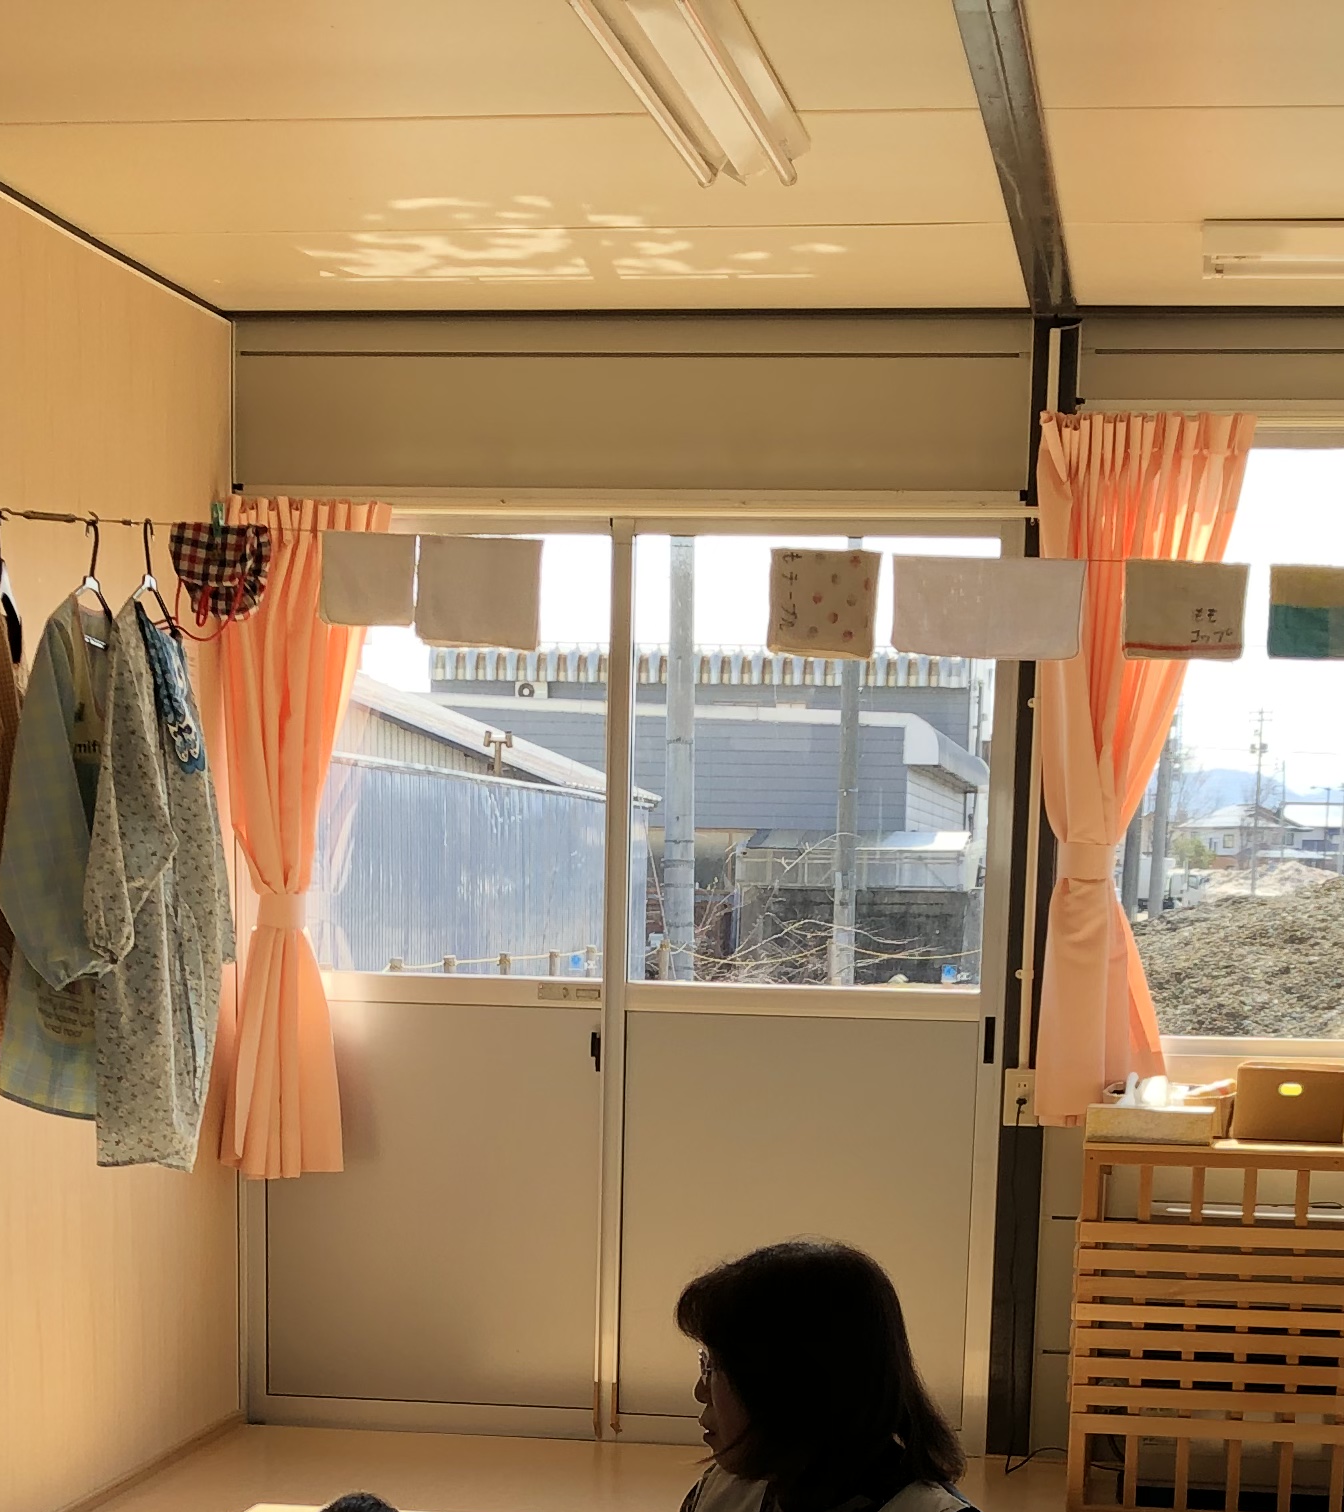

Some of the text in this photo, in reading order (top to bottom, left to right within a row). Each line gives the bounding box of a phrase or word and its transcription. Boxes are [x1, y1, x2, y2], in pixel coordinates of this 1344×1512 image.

[1190, 628, 1233, 643] コップ
[74, 740, 103, 753] mif
